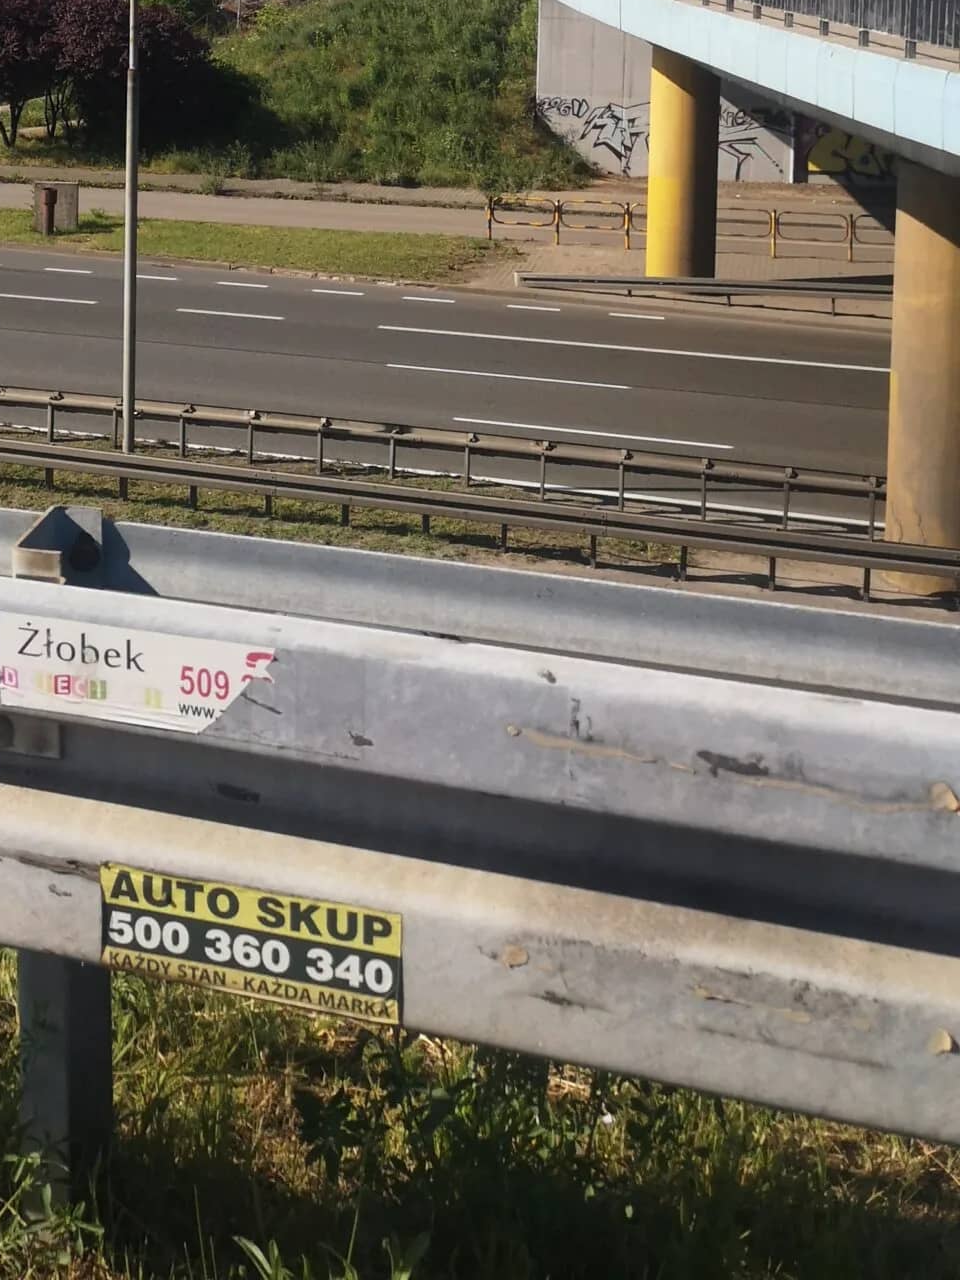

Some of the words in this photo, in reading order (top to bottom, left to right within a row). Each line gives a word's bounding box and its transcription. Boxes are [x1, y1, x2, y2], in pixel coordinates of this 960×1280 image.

[17, 621, 145, 672] Żłobek
[179, 665, 230, 700] 509
[110, 870, 240, 919] AUTO
[257, 897, 393, 945] SKUP
[108, 910, 189, 955] 500
[204, 929, 291, 974] 360
[306, 948, 393, 993] 340
[109, 950, 171, 975] KAŻDY
[177, 964, 226, 985] STAN
[244, 975, 312, 1004] KAŻDA
[319, 991, 390, 1018] MARKA
